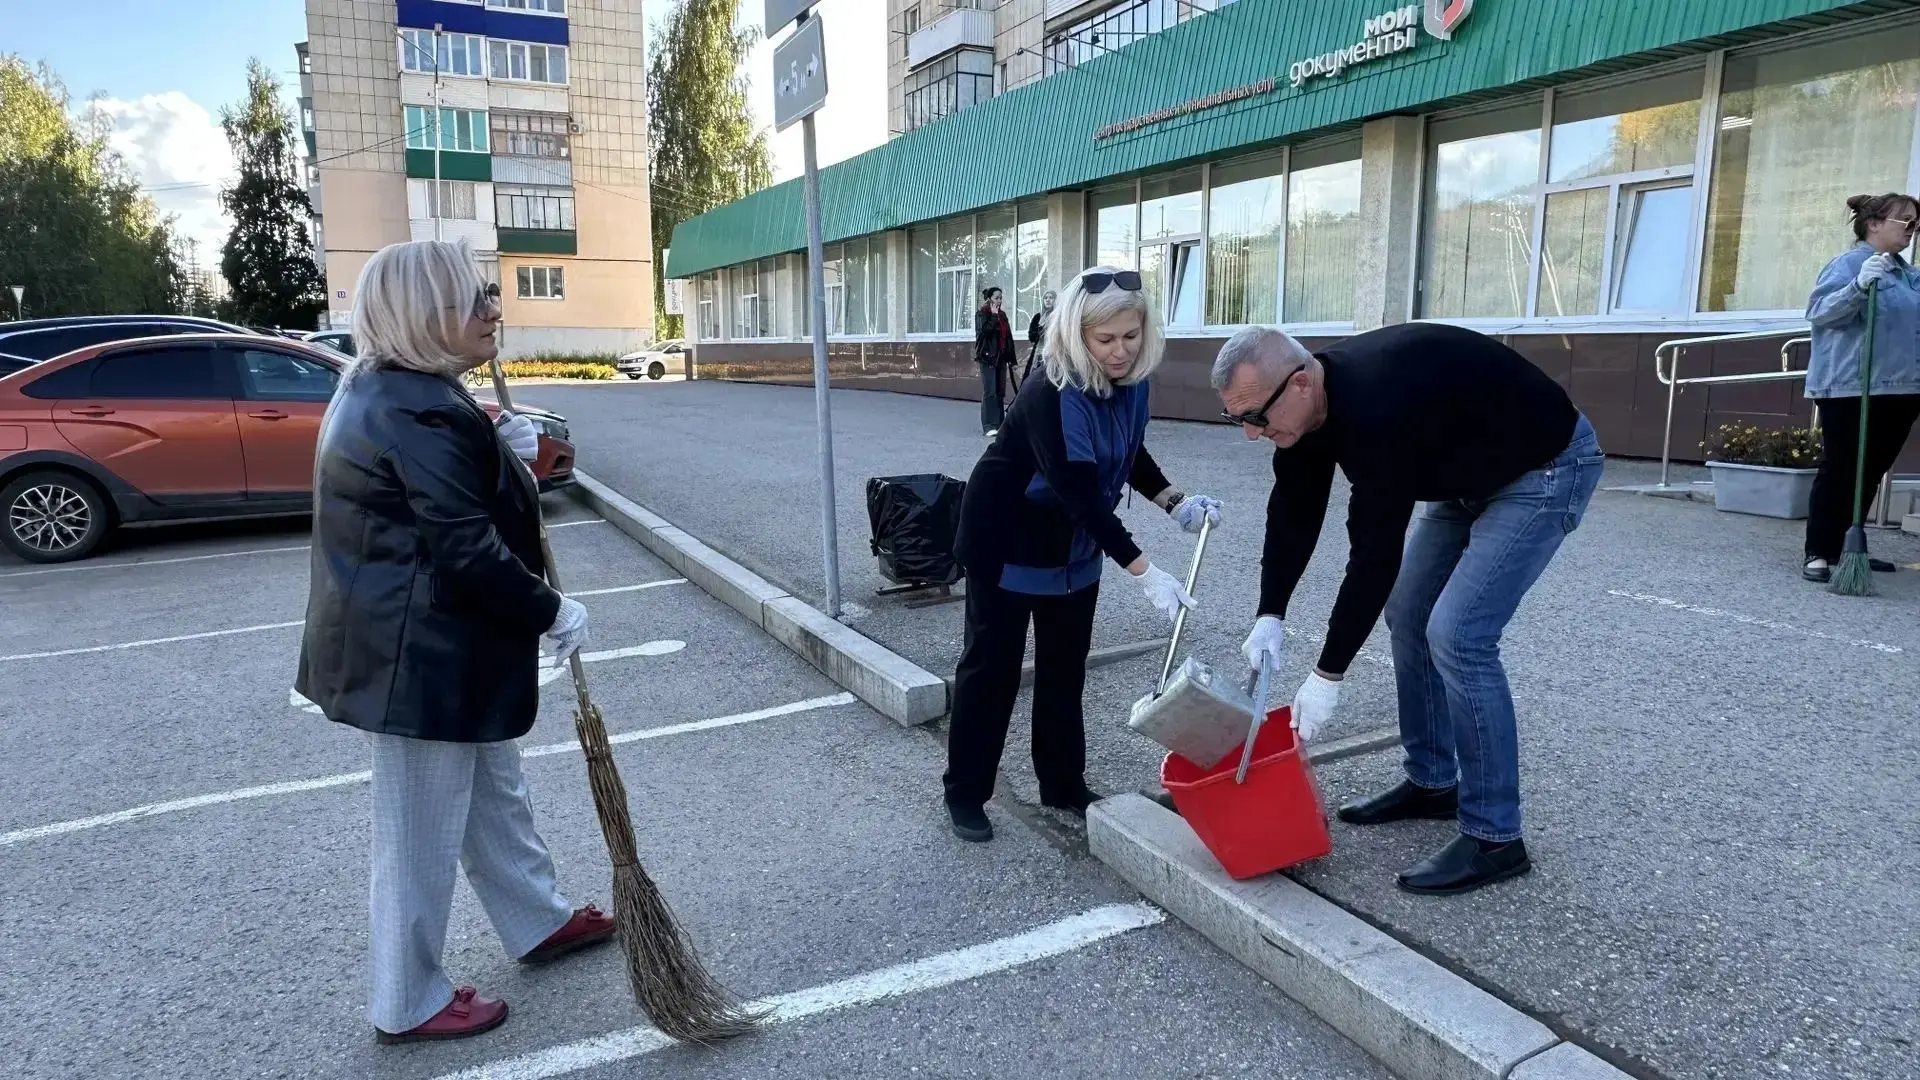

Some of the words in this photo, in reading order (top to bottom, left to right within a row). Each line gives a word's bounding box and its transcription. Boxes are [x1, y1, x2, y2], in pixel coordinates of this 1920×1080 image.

[1289, 27, 1416, 87] документы
[791, 60, 798, 95] 5
[1181, 86, 1249, 115] муниципальных
[1251, 76, 1276, 96] услуг
